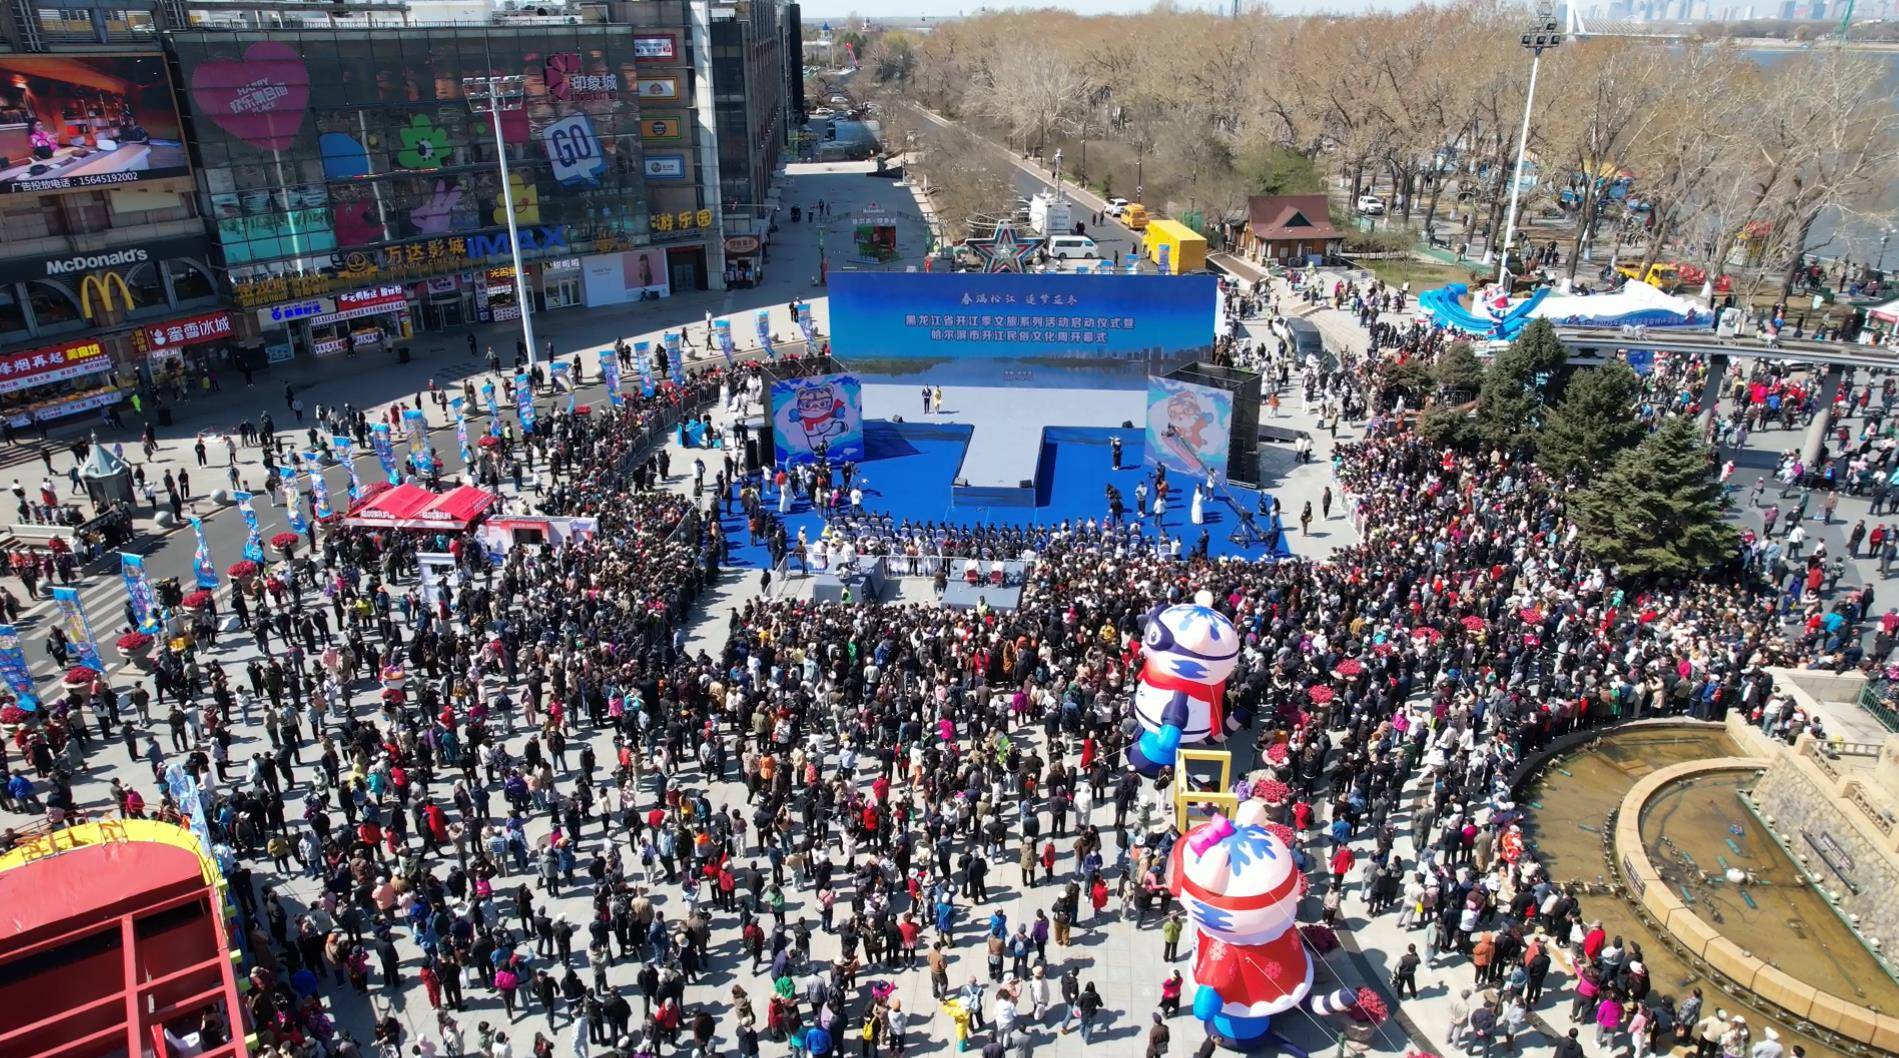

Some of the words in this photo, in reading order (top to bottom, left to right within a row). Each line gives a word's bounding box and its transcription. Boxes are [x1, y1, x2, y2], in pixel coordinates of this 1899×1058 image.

[572, 74, 617, 91] 印象城
[552, 124, 592, 168] GO
[384, 236, 466, 263] 万达影城
[466, 224, 566, 260] IMAX
[46, 248, 148, 275] McDonald's
[167, 316, 231, 342] 蜜雪冰城
[931, 329, 1108, 343] 哈尔滨市开江民俗文化周开幕式
